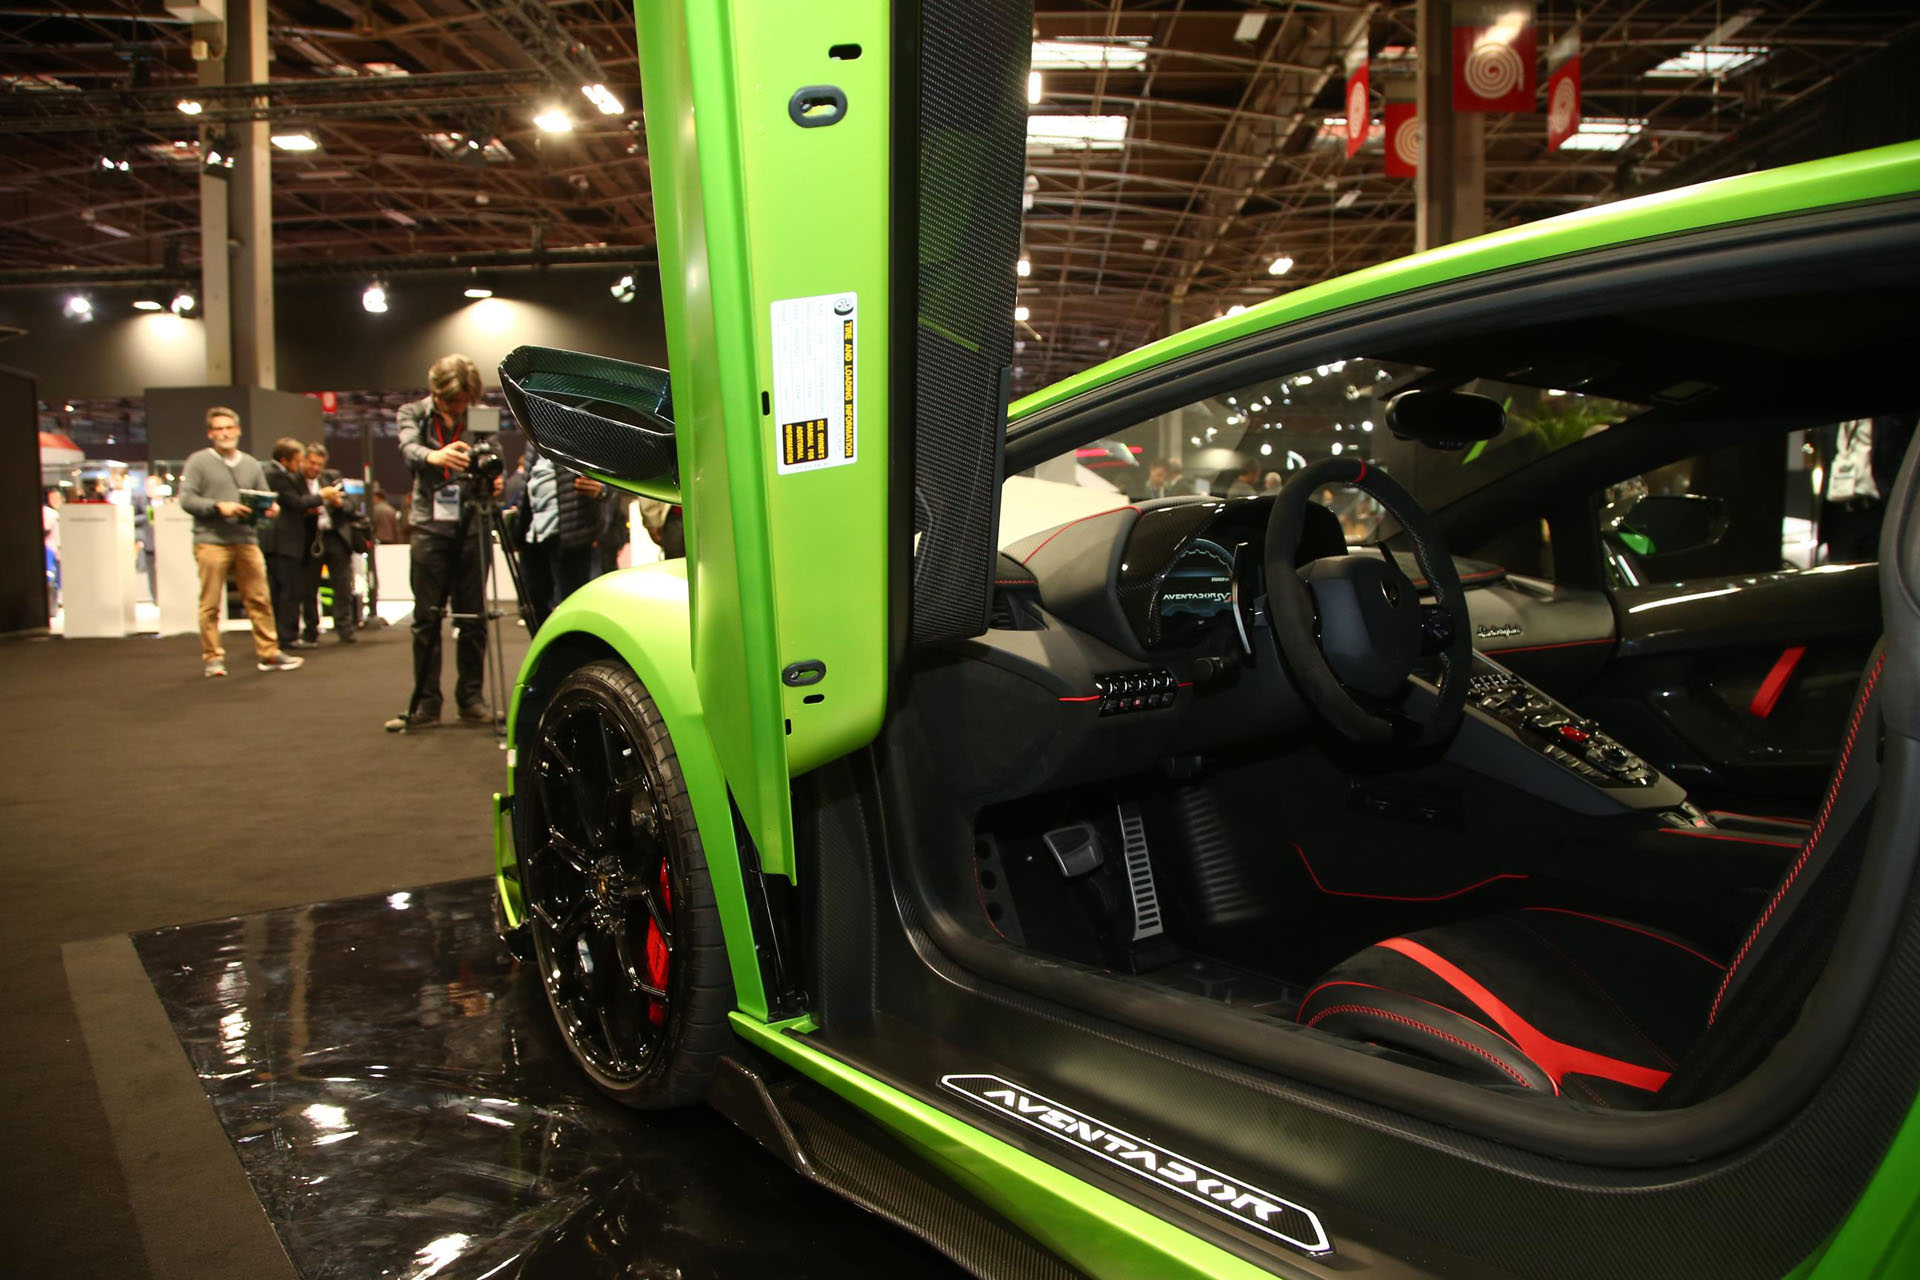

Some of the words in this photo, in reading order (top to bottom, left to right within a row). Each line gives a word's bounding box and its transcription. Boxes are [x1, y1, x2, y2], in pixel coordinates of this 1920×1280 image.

[844, 322, 853, 340] TIRE
[844, 344, 853, 361] AND
[845, 365, 853, 400] LOADING
[817, 420, 825, 431] SEE
[845, 404, 853, 456] INFORMATION
[796, 426, 804, 460] ADDITIONAL
[983, 1090, 1282, 1222] AVENTADOR
